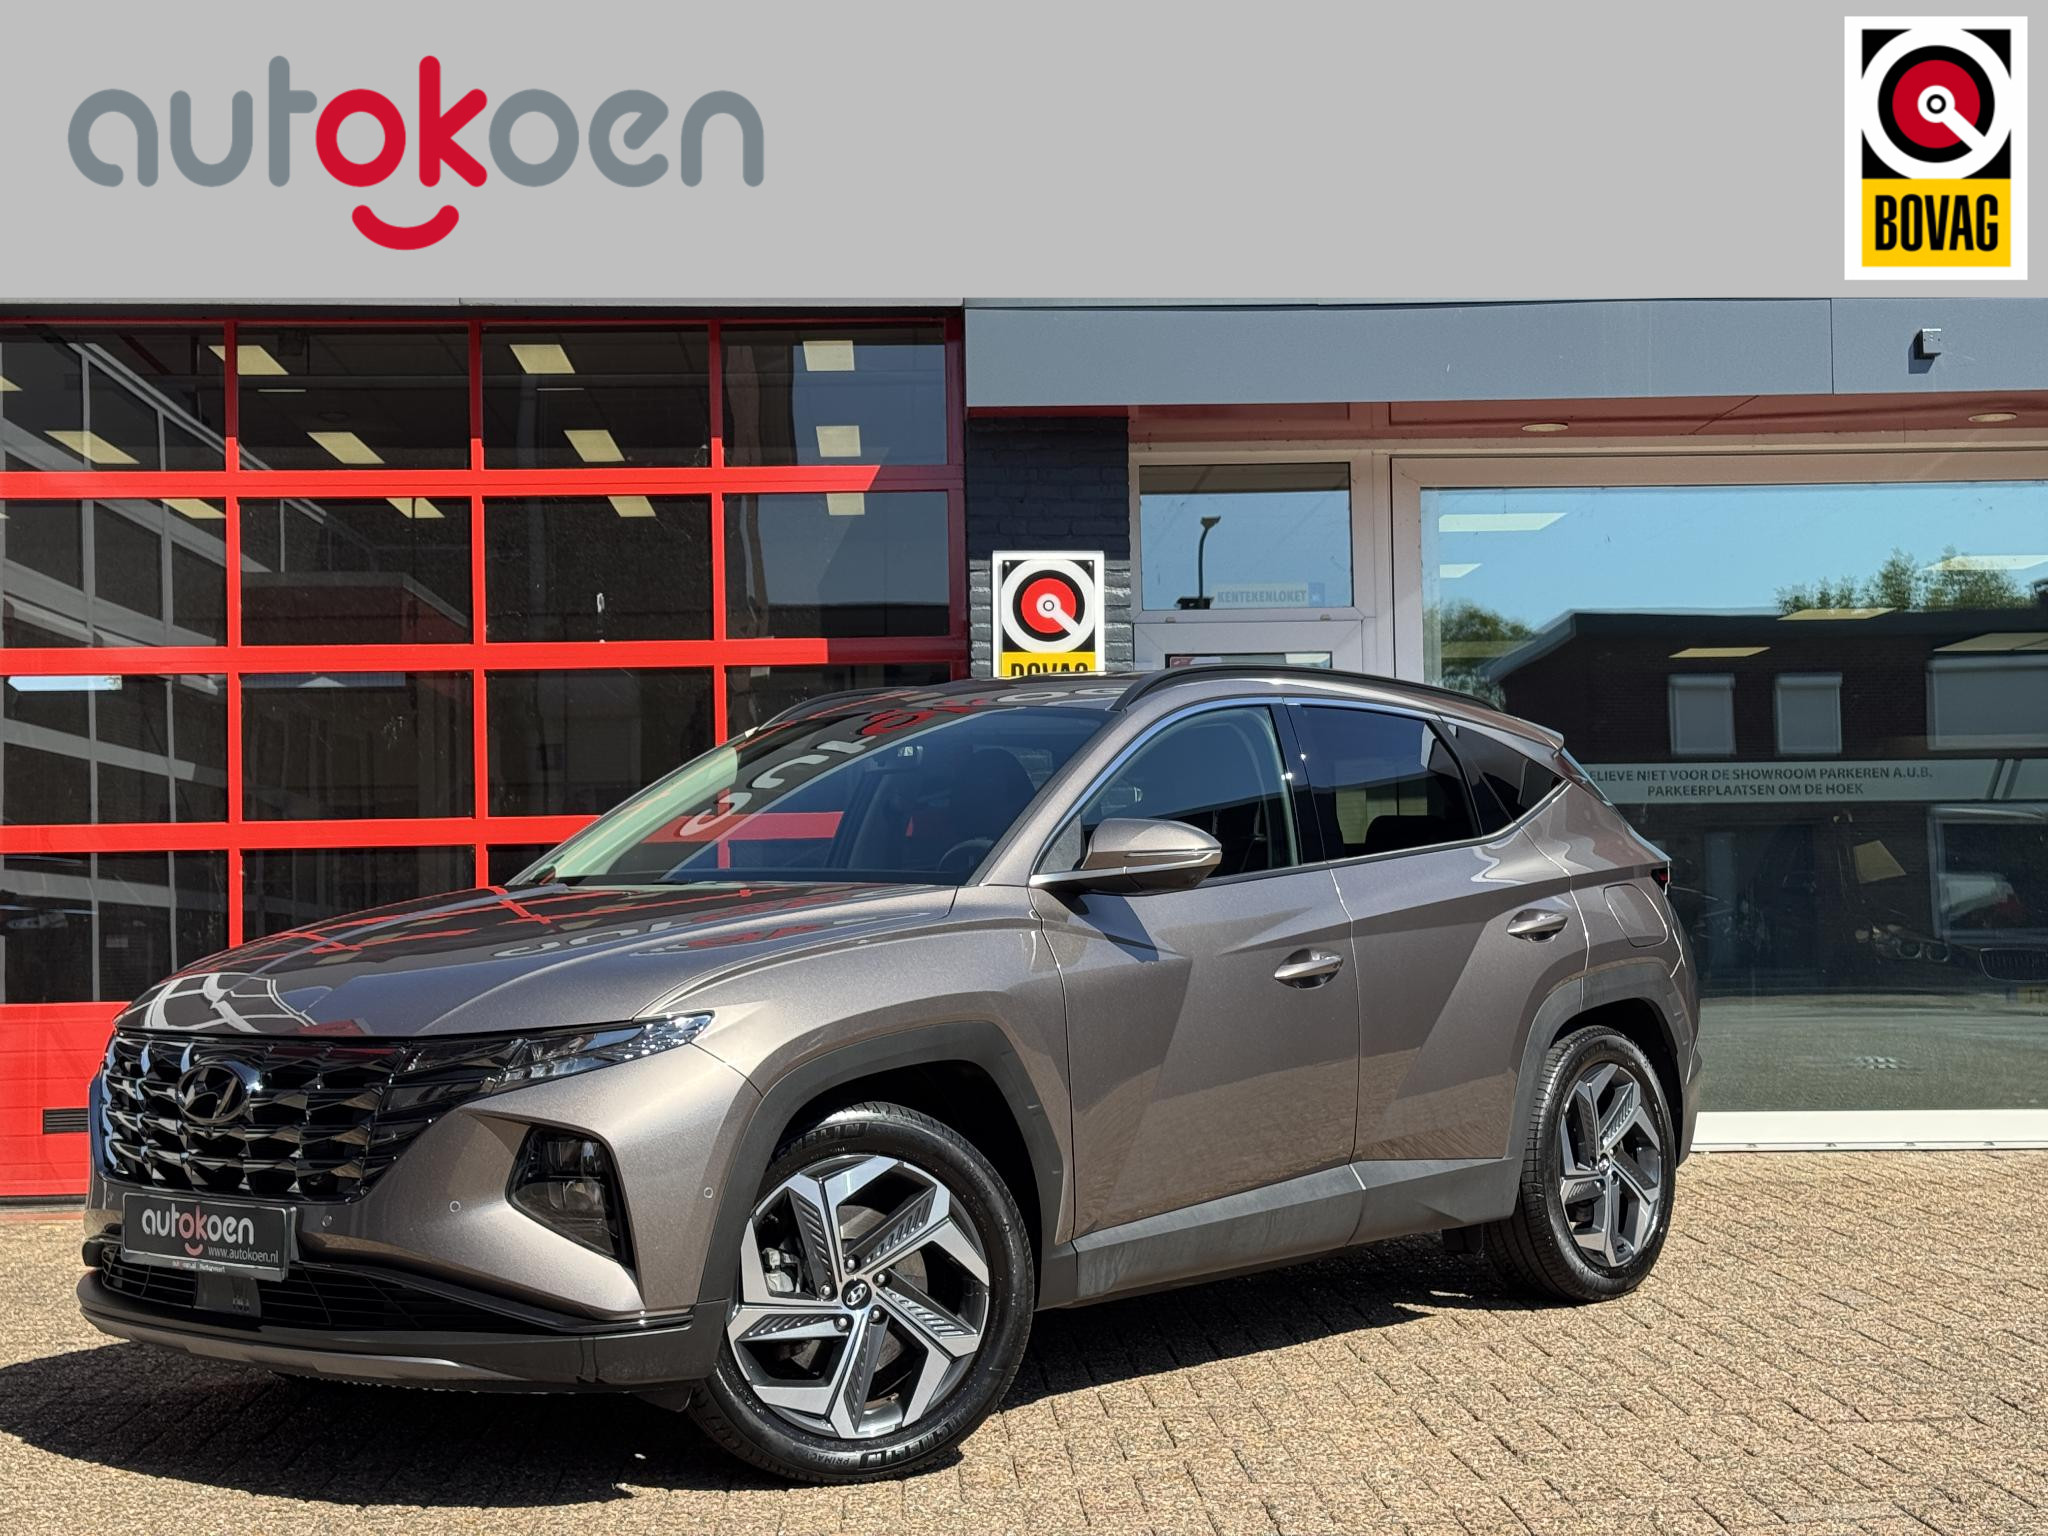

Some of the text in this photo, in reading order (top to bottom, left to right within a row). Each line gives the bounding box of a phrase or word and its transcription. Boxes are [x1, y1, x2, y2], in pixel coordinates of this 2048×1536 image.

[1217, 590, 1306, 602] KENTEKENLOKET
[1590, 767, 1933, 781] ELIEVE NIET VOOR DE SHOWROOM PARKEREN A.U.B.
[1648, 783, 1863, 796] PARKEERPLAATSEN OM DE HOEK
[141, 1203, 254, 1245] autokoen
[208, 1245, 279, 1264] www.autokoen.nl
